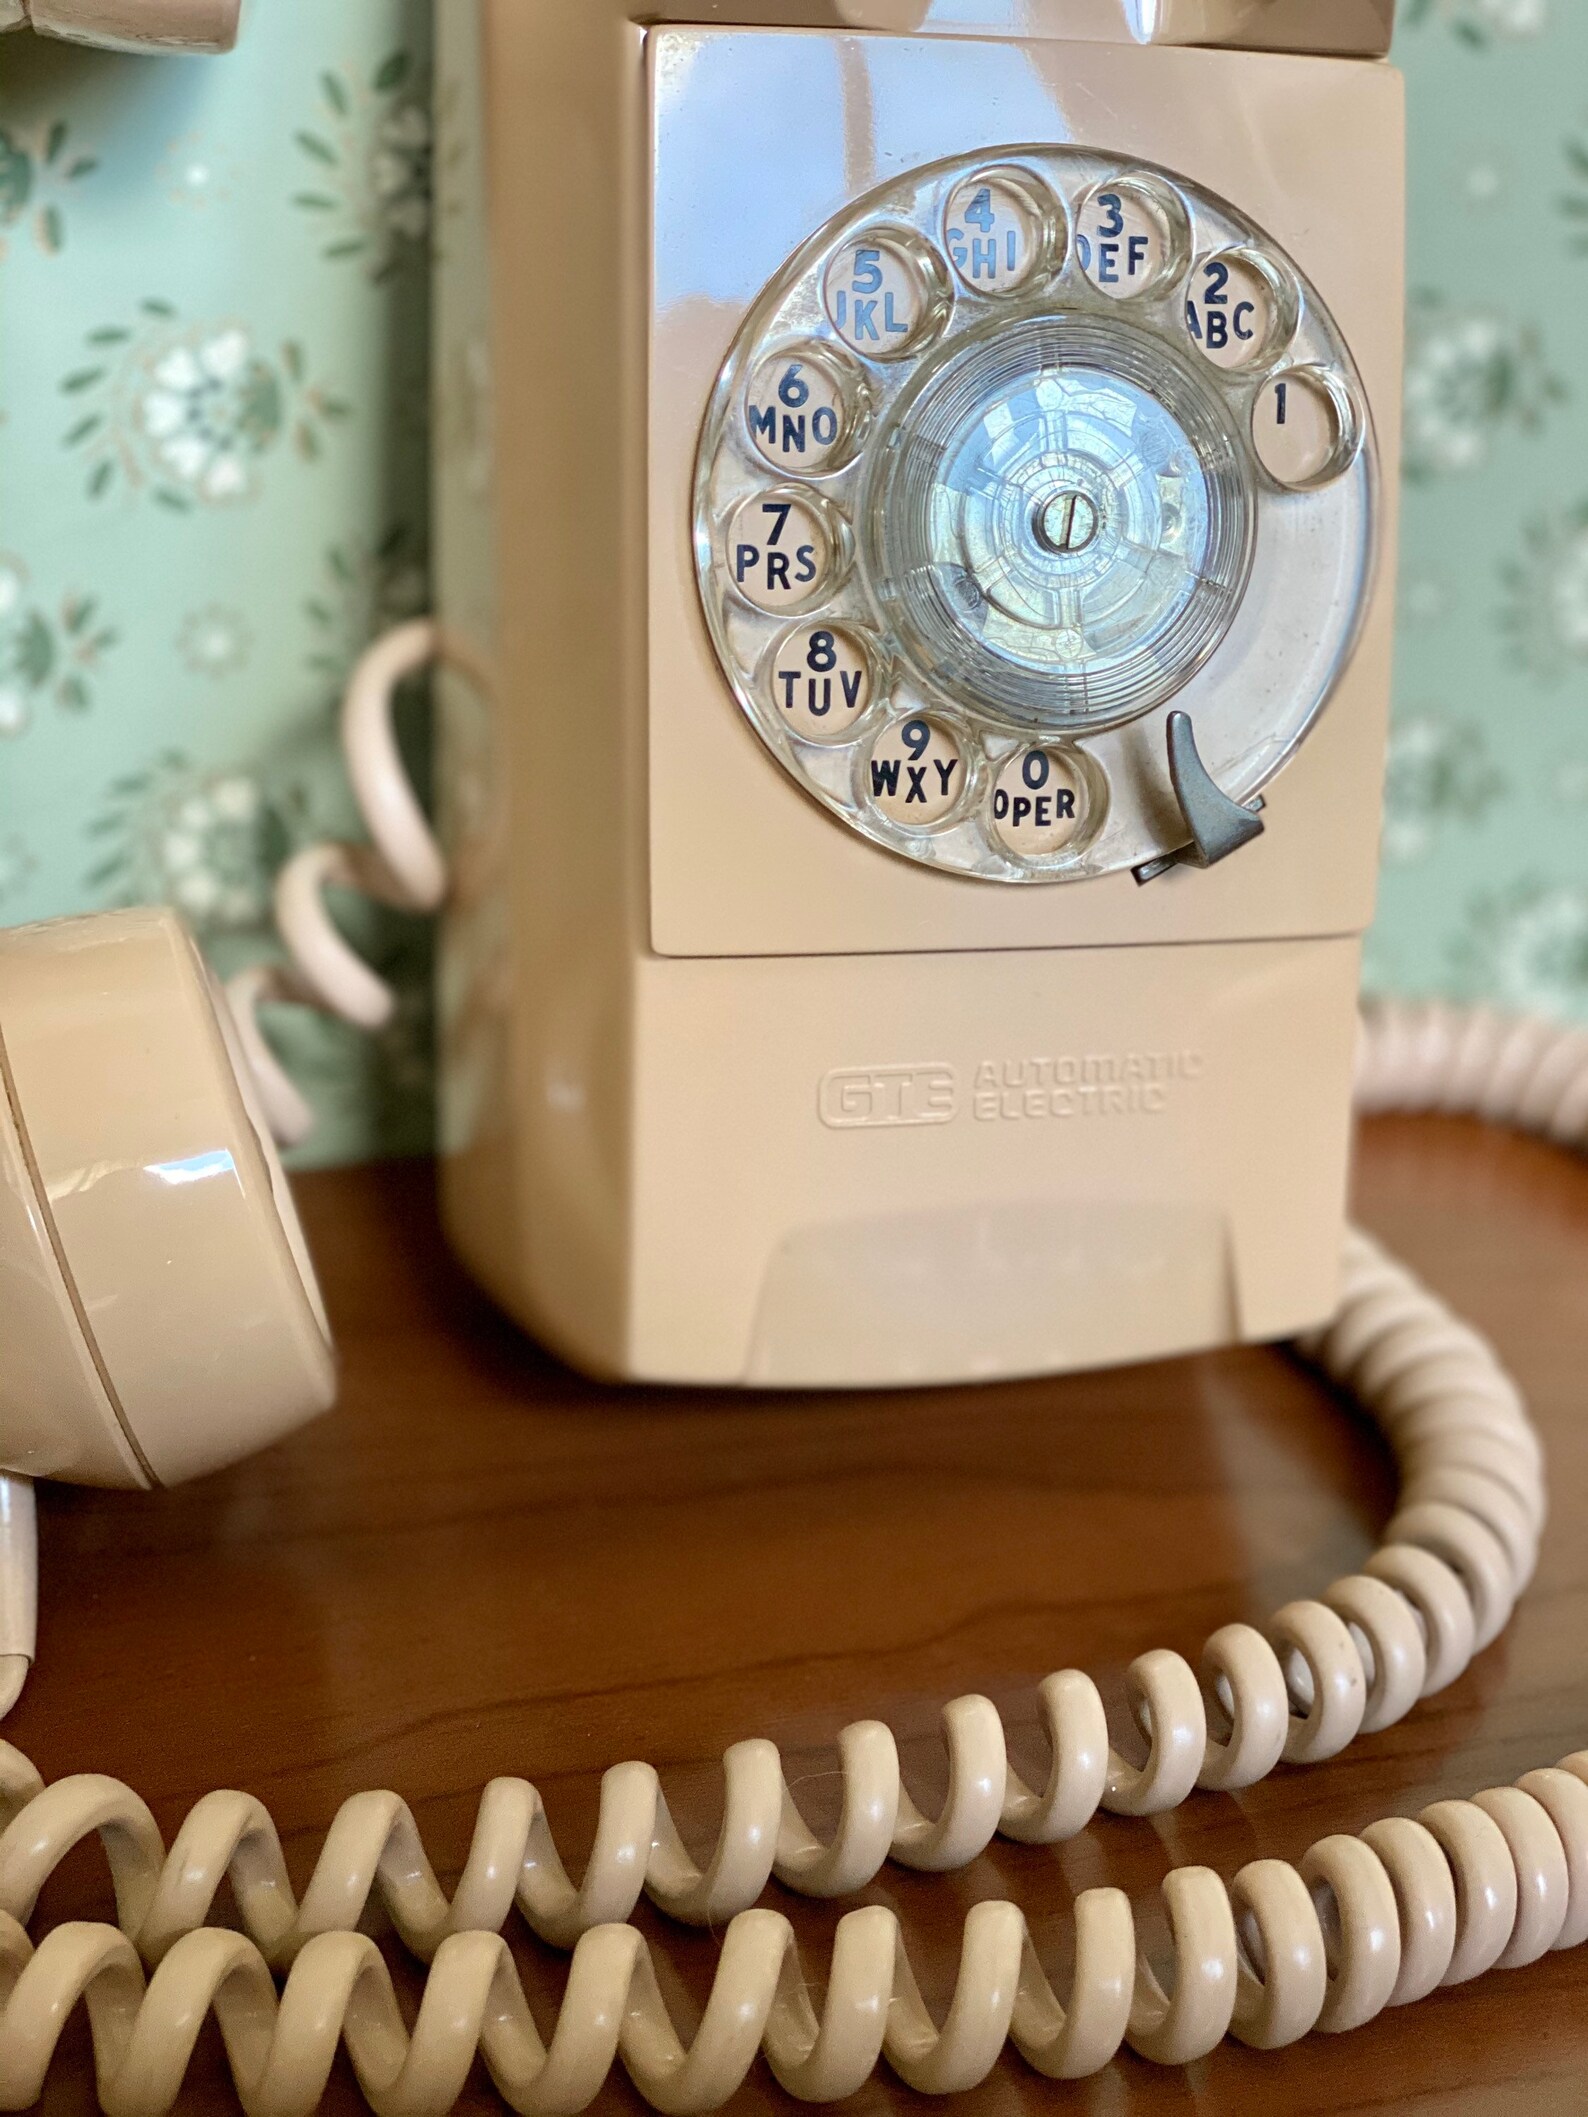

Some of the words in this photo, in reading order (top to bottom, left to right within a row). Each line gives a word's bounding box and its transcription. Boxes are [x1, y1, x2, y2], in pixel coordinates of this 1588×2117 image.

[964, 188, 995, 232] 4
[1096, 194, 1124, 238] 3
[852, 249, 883, 294] 5
[946, 227, 1016, 279] GHI
[1203, 262, 1228, 304] 2
[834, 290, 908, 340] JKL
[777, 364, 809, 408] 6
[1274, 383, 1286, 424] 1
[748, 405, 838, 453] MNO
[762, 503, 791, 546] 7
[735, 544, 817, 590] PRS
[806, 630, 837, 672] 8
[778, 670, 862, 716] TUV
[901, 720, 930, 761] 9
[871, 758, 958, 803] WXY
[994, 789, 1075, 827] OPER
[973, 1050, 1202, 1089] AUTOMATIC
[973, 1083, 1169, 1122] ELECTRIC
